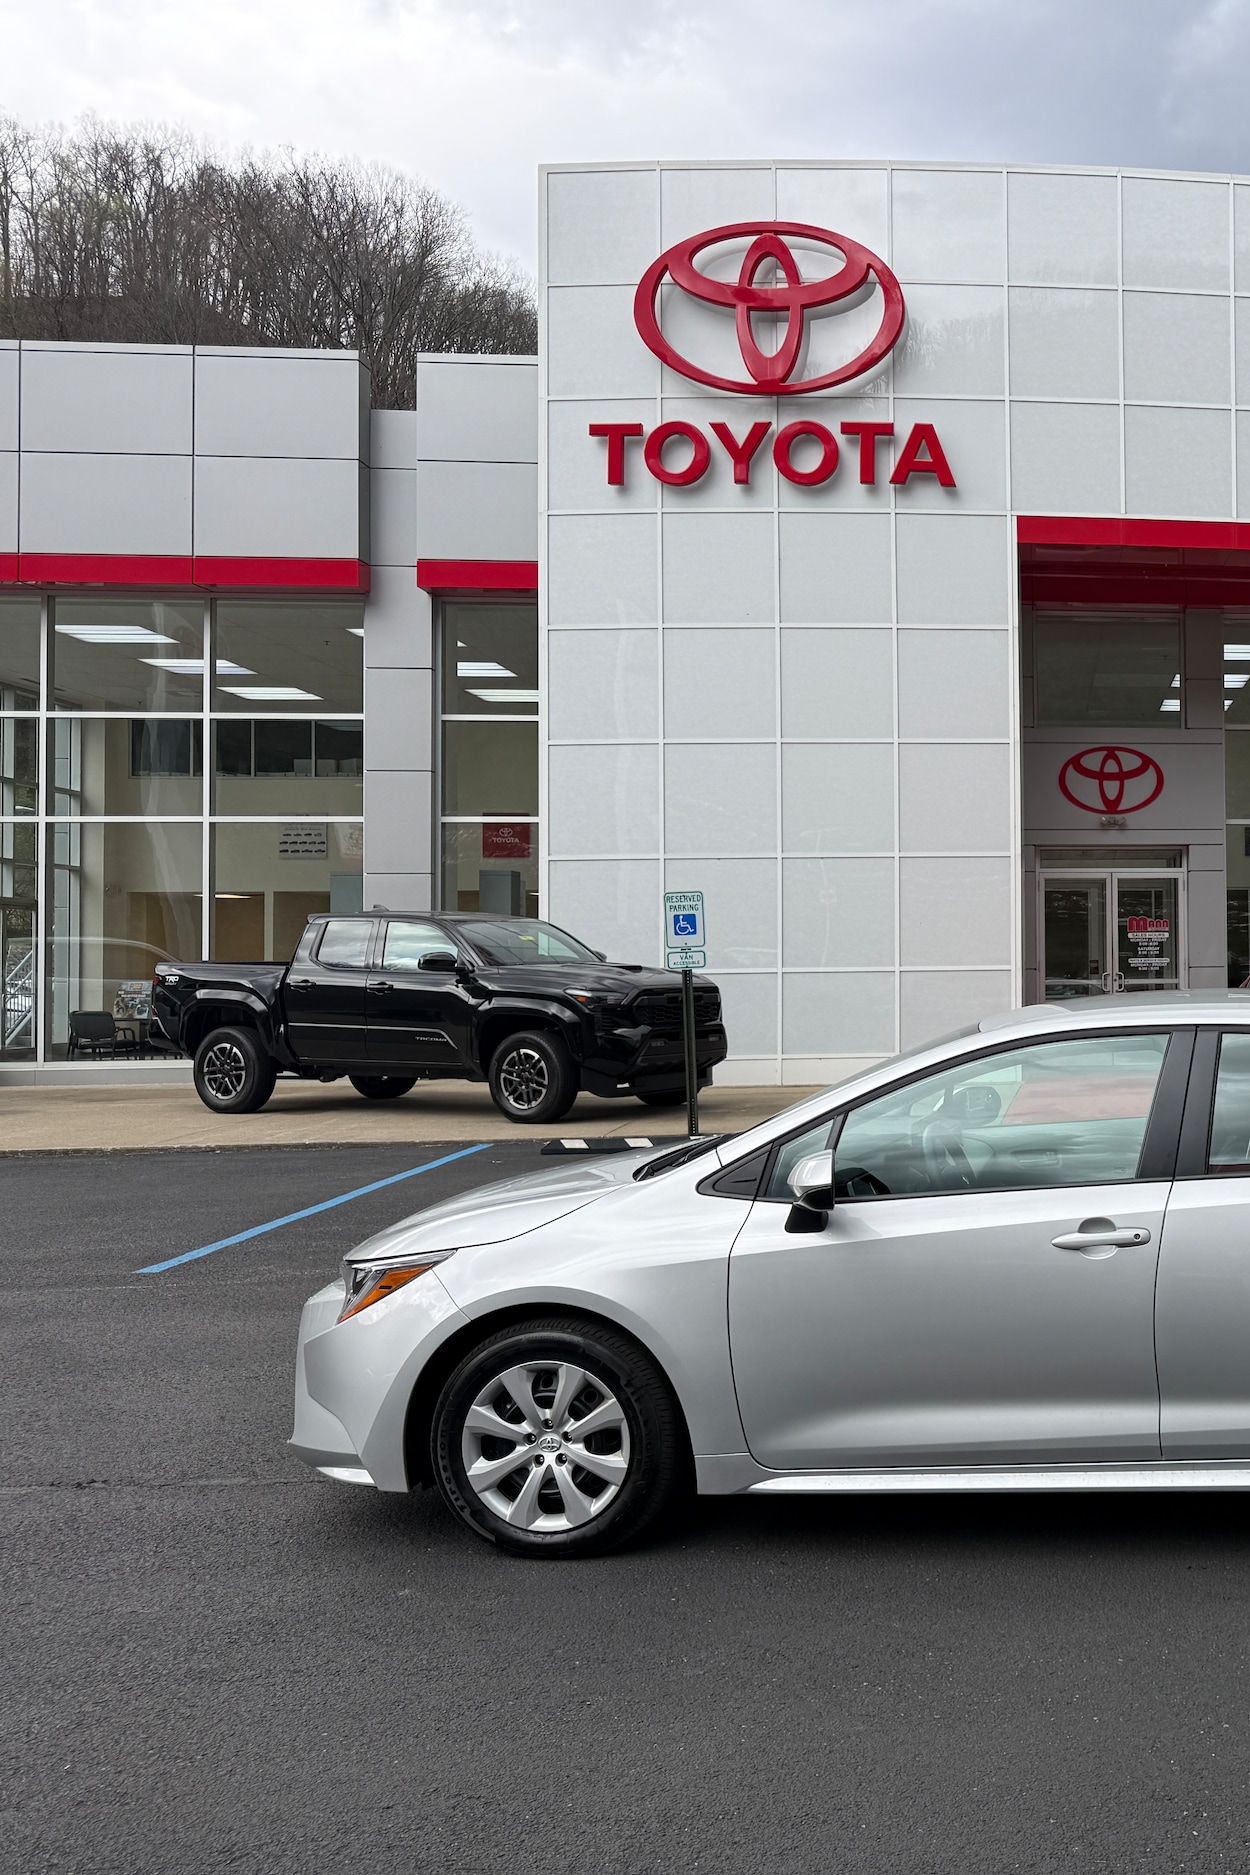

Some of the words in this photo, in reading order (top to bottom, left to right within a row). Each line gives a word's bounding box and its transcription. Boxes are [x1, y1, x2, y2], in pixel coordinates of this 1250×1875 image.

[588, 420, 956, 487] TOYOTA
[667, 895, 701, 903] RESERVED
[669, 903, 699, 912] PARKING
